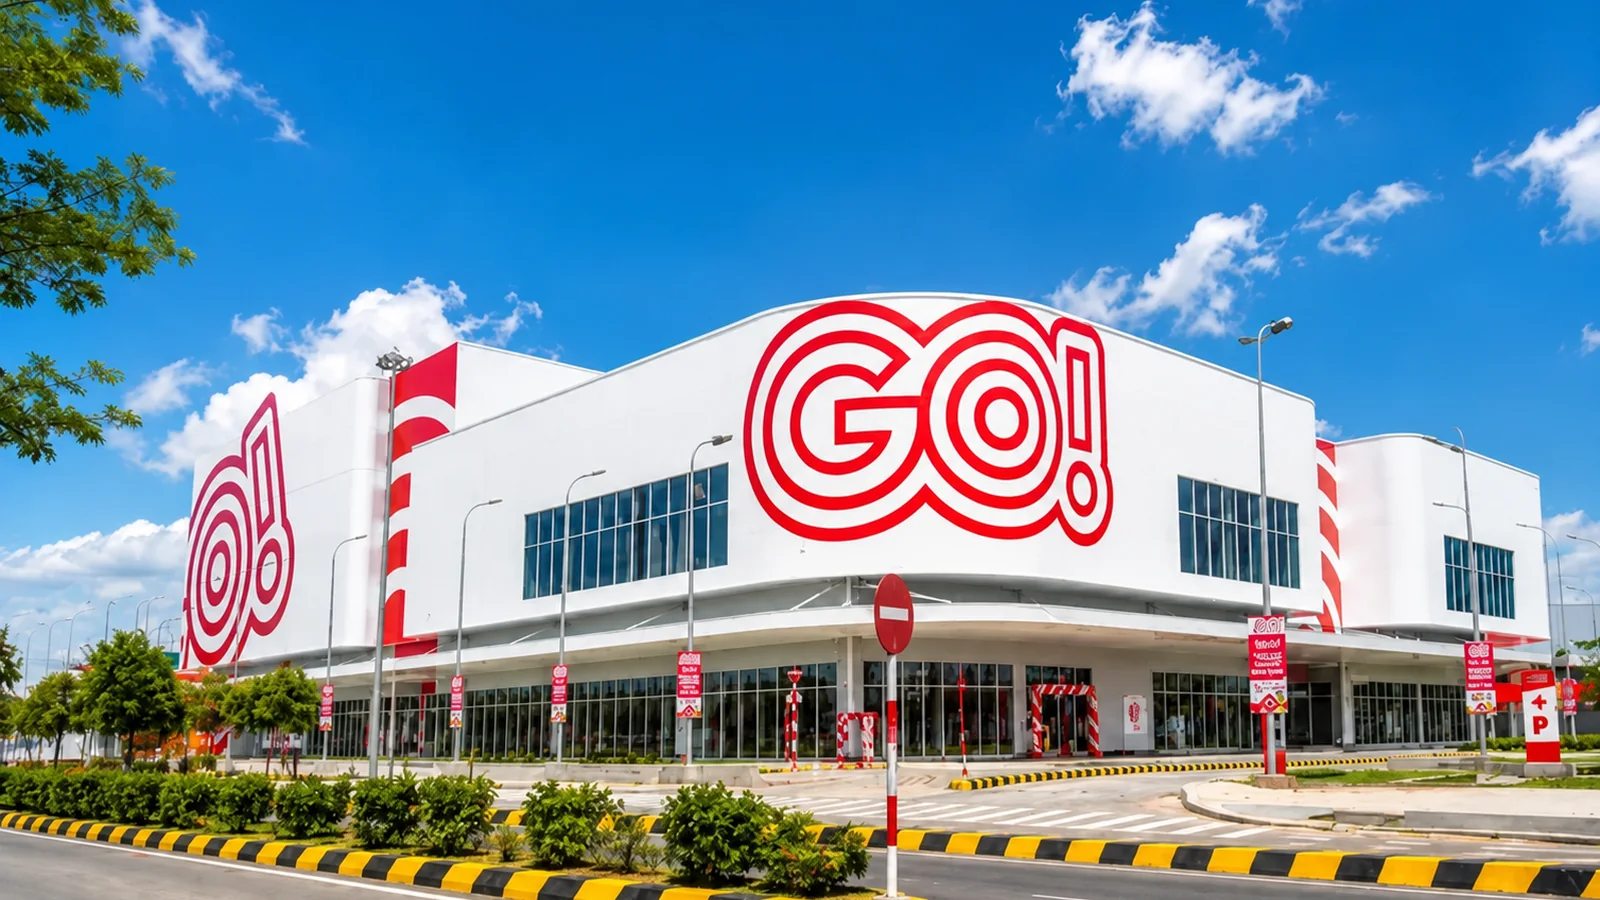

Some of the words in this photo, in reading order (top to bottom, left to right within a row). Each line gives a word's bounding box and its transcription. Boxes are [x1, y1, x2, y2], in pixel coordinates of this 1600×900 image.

[182, 392, 295, 669] O!
[743, 299, 1113, 546] GO!
[1533, 715, 1549, 735] P
